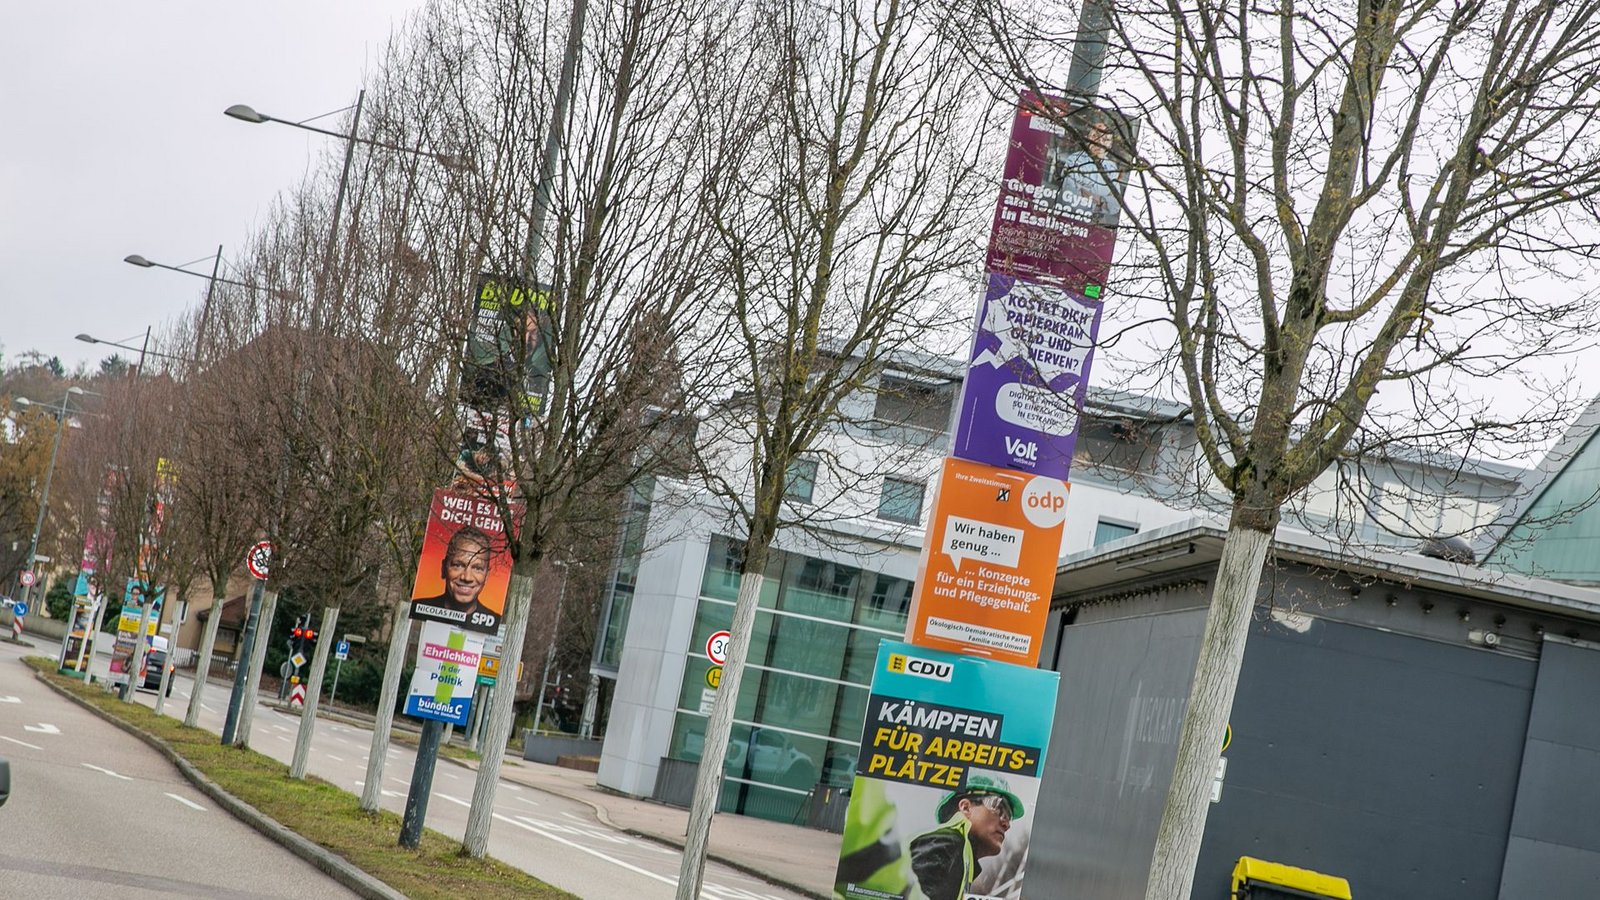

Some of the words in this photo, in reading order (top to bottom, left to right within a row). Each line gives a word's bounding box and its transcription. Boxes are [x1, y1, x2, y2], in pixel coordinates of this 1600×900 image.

[1008, 178, 1059, 199] Gregor
[1062, 190, 1093, 208] Gysi
[1001, 206, 1017, 221] in
[1008, 293, 1059, 316] KOSTET
[1061, 306, 1088, 325] DICH
[1006, 310, 1084, 340] PAPIERKRAM
[1048, 336, 1072, 352] UND
[1027, 348, 1079, 372] NERVEN?
[1012, 400, 1023, 408] SO
[1024, 403, 1054, 416] EINFACH
[1017, 410, 1025, 418] IN
[1005, 436, 1038, 461] Volt
[955, 472, 968, 481] Ihre
[969, 476, 1012, 489] Zweitstimme:
[443, 496, 473, 513] WEIL
[476, 502, 491, 515] ES
[1027, 491, 1065, 513] ödp
[441, 509, 473, 526] DICH
[954, 521, 976, 535] Wir
[978, 526, 1016, 544] haben
[950, 538, 989, 556] genug
[978, 567, 1031, 587] Konzepte
[936, 571, 955, 584] für
[956, 576, 975, 588] ein
[977, 580, 1041, 603] Erziehungs-
[934, 586, 957, 598] und
[959, 590, 1031, 614] Pflegegehalt.
[417, 605, 448, 616] NICOLAS
[448, 611, 466, 620] FINK
[471, 612, 495, 627] SPD
[968, 635, 990, 645] Familie
[1004, 642, 1028, 653] Umwelt
[1011, 634, 1030, 645] Partei
[425, 646, 477, 664] Ehrlichkeit
[448, 665, 461, 673] der
[712, 671, 722, 684] H
[908, 660, 951, 679] CDU
[430, 672, 463, 687] Politik
[418, 697, 454, 713] bündnis
[455, 704, 463, 715] C
[878, 700, 998, 739] KÄMPFEN
[873, 726, 923, 753] FÜR
[925, 737, 1035, 770] ARBEITS-
[868, 754, 964, 787] PLÄTZE
